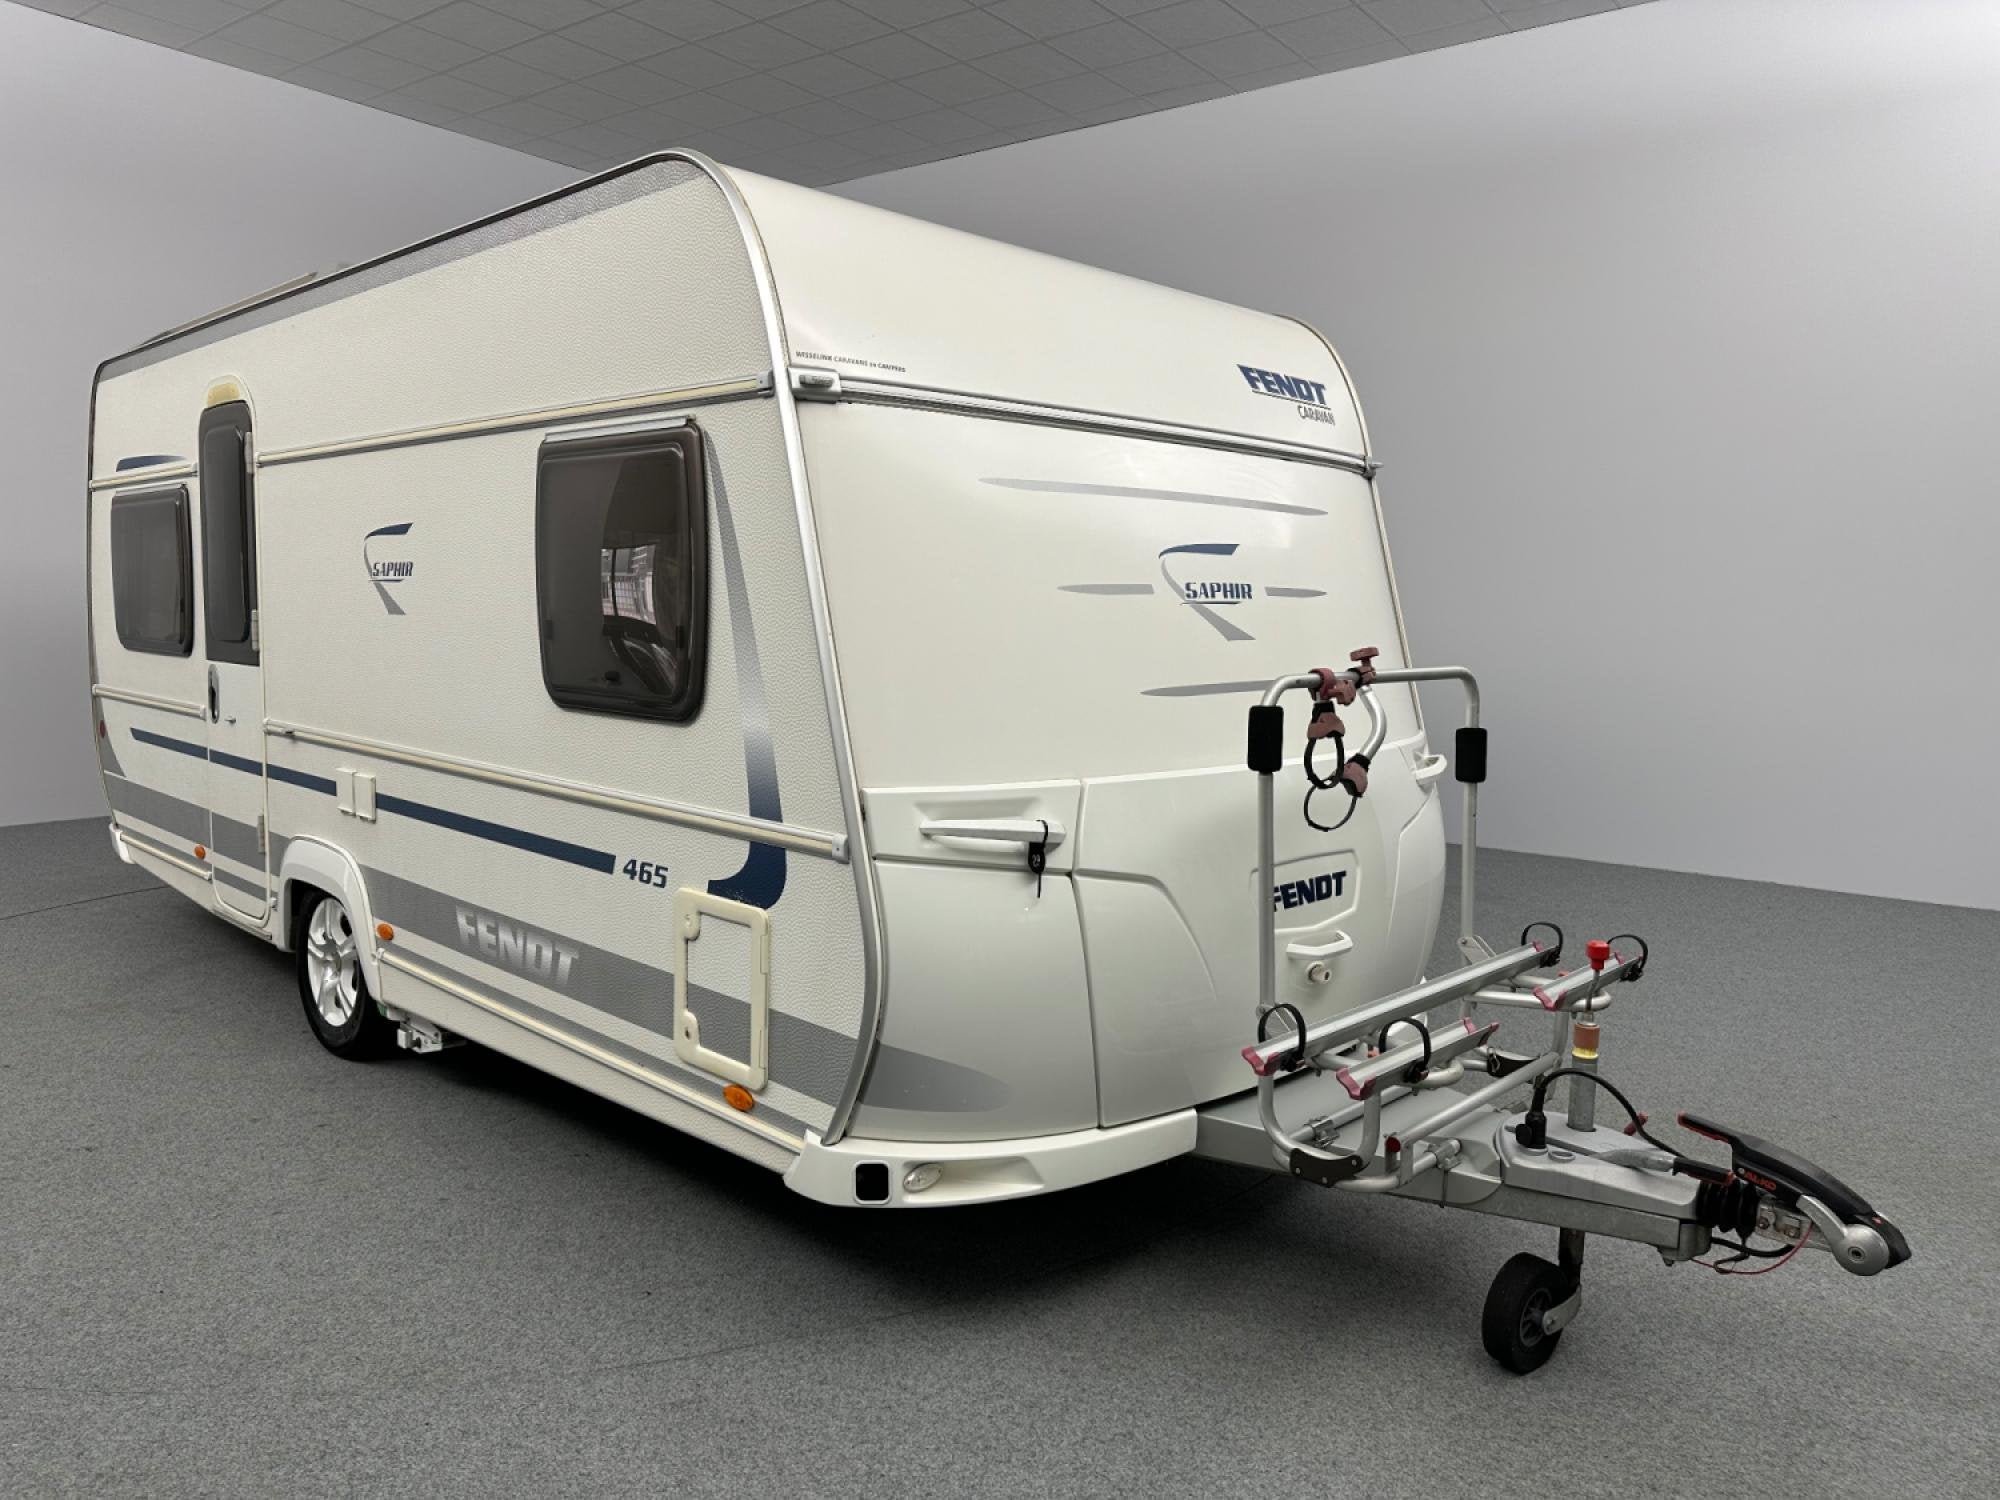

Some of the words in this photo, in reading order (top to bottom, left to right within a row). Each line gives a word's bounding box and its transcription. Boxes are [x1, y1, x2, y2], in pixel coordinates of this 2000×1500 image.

[1236, 363, 1326, 405] FENDT
[1297, 405, 1335, 425] CARAVAN
[372, 561, 413, 577] SAPHIR
[1184, 581, 1253, 600] SAPHIR
[622, 859, 669, 889] 465
[455, 904, 580, 986] FENDT
